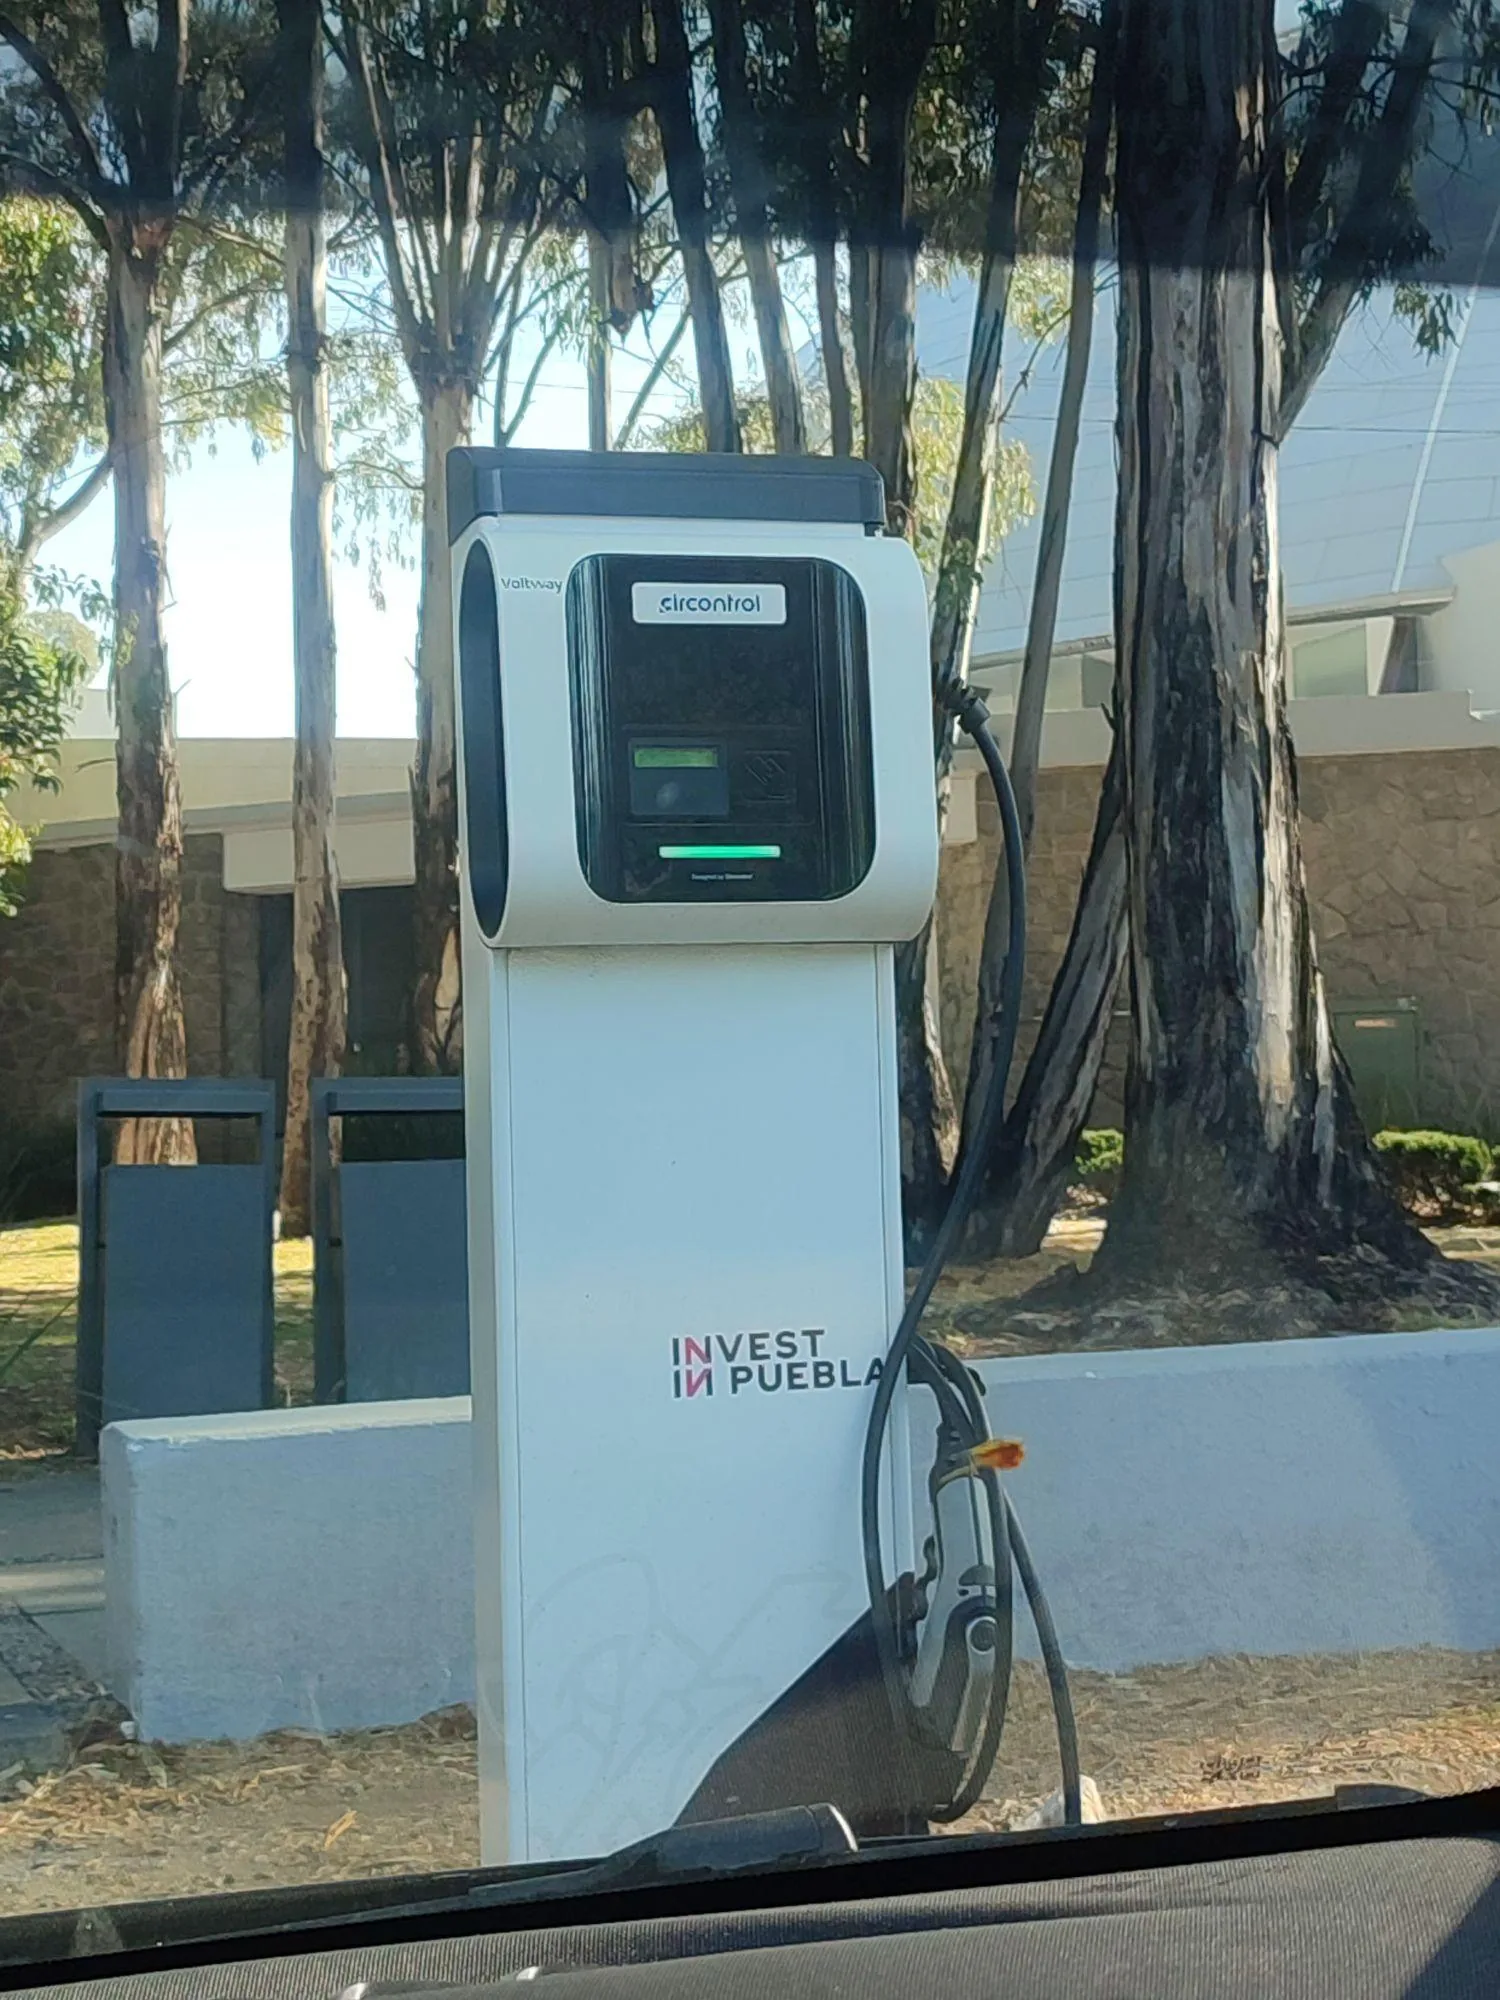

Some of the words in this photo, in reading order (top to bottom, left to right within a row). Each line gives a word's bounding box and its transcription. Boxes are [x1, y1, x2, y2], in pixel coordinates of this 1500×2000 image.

[501, 577, 562, 594] Voltway
[659, 593, 761, 613] circontrol
[671, 1329, 825, 1366] INVEST
[730, 1357, 885, 1394] PUEBLA
